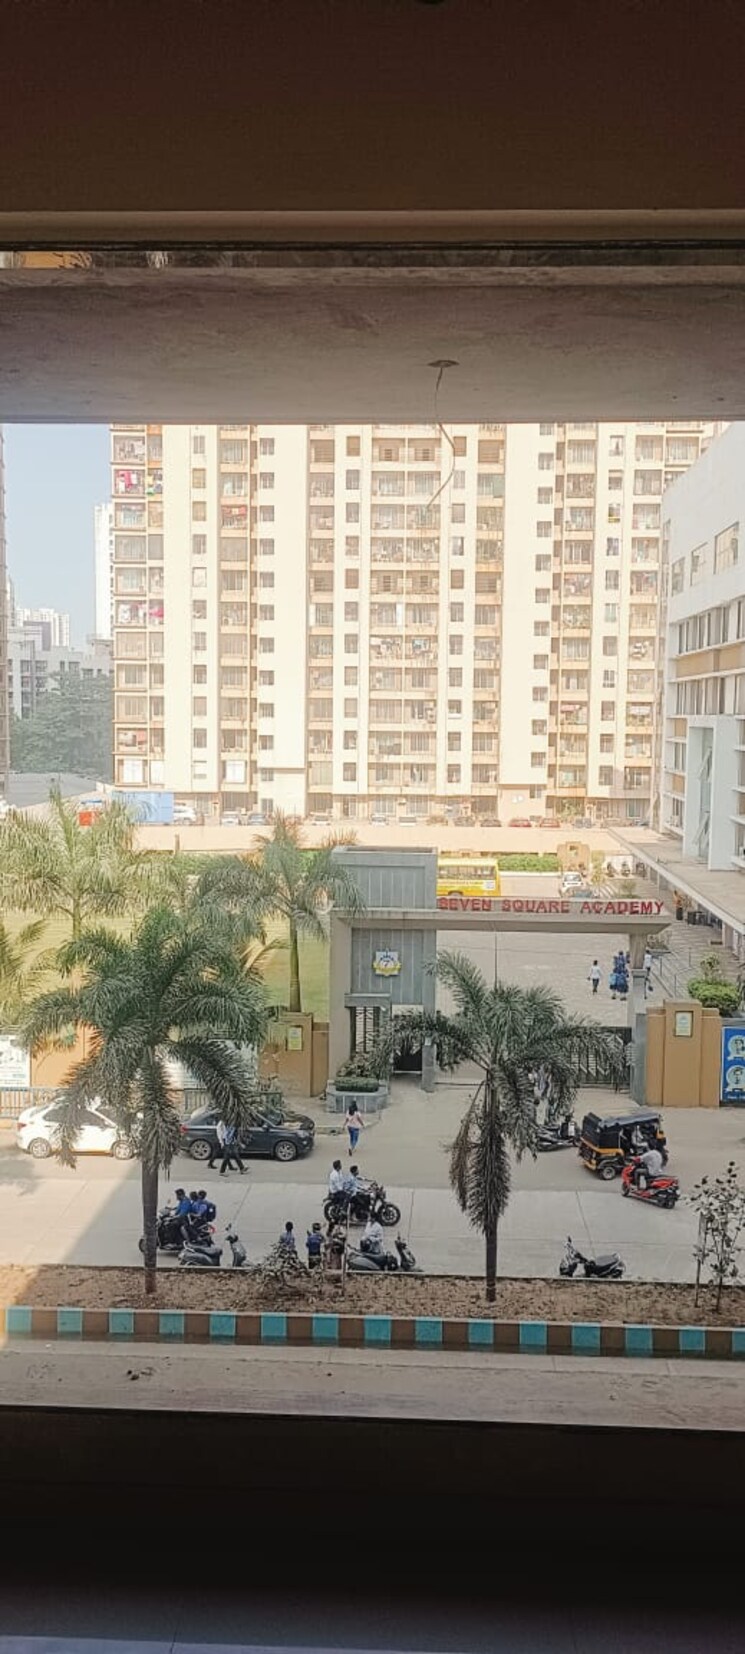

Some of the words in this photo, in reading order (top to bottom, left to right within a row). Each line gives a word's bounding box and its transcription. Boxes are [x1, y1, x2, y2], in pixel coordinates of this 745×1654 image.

[437, 898, 492, 911] SEVEN
[502, 899, 570, 914] SQUARE
[580, 900, 664, 916] ACADEMY
